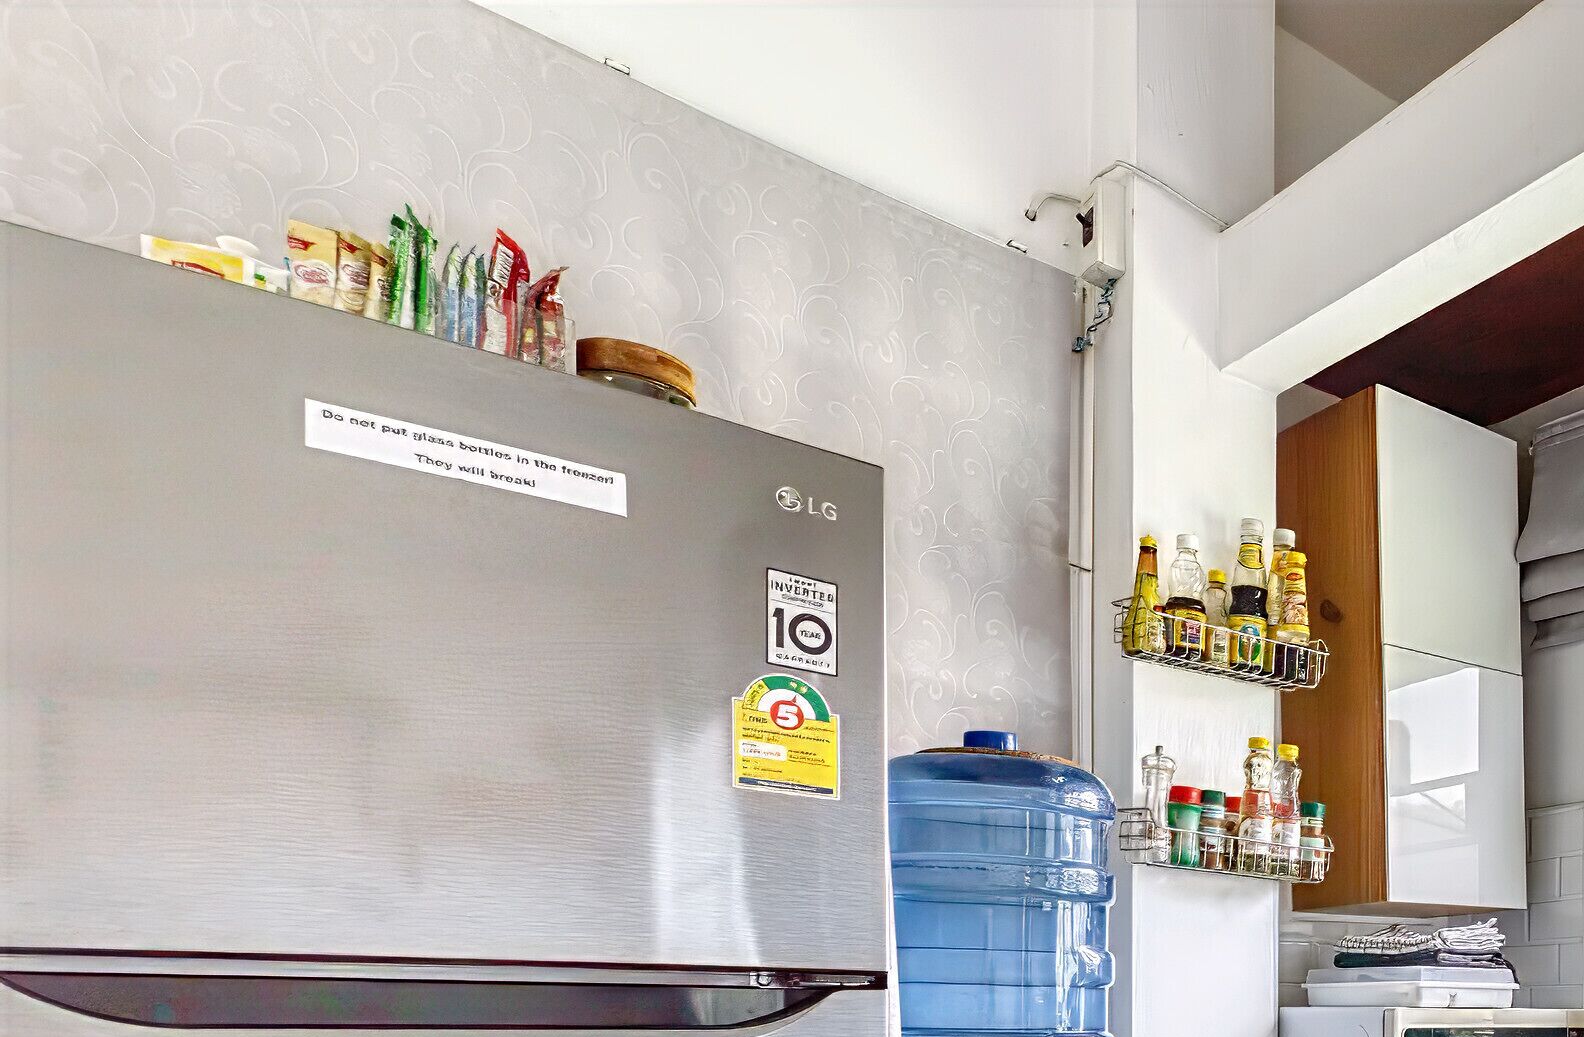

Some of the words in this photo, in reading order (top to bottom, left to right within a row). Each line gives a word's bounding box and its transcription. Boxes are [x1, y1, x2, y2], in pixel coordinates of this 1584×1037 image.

[321, 409, 344, 421] Do
[350, 417, 376, 429] not
[381, 424, 408, 437] put
[413, 431, 454, 447] glass
[459, 441, 512, 461] bottles
[516, 454, 529, 465] in
[534, 459, 556, 471] the
[414, 453, 452, 471] They
[457, 464, 485, 476] will
[808, 496, 837, 521] LG
[770, 579, 834, 603] INVERTER
[772, 607, 833, 655] 10
[775, 704, 799, 729] 5
